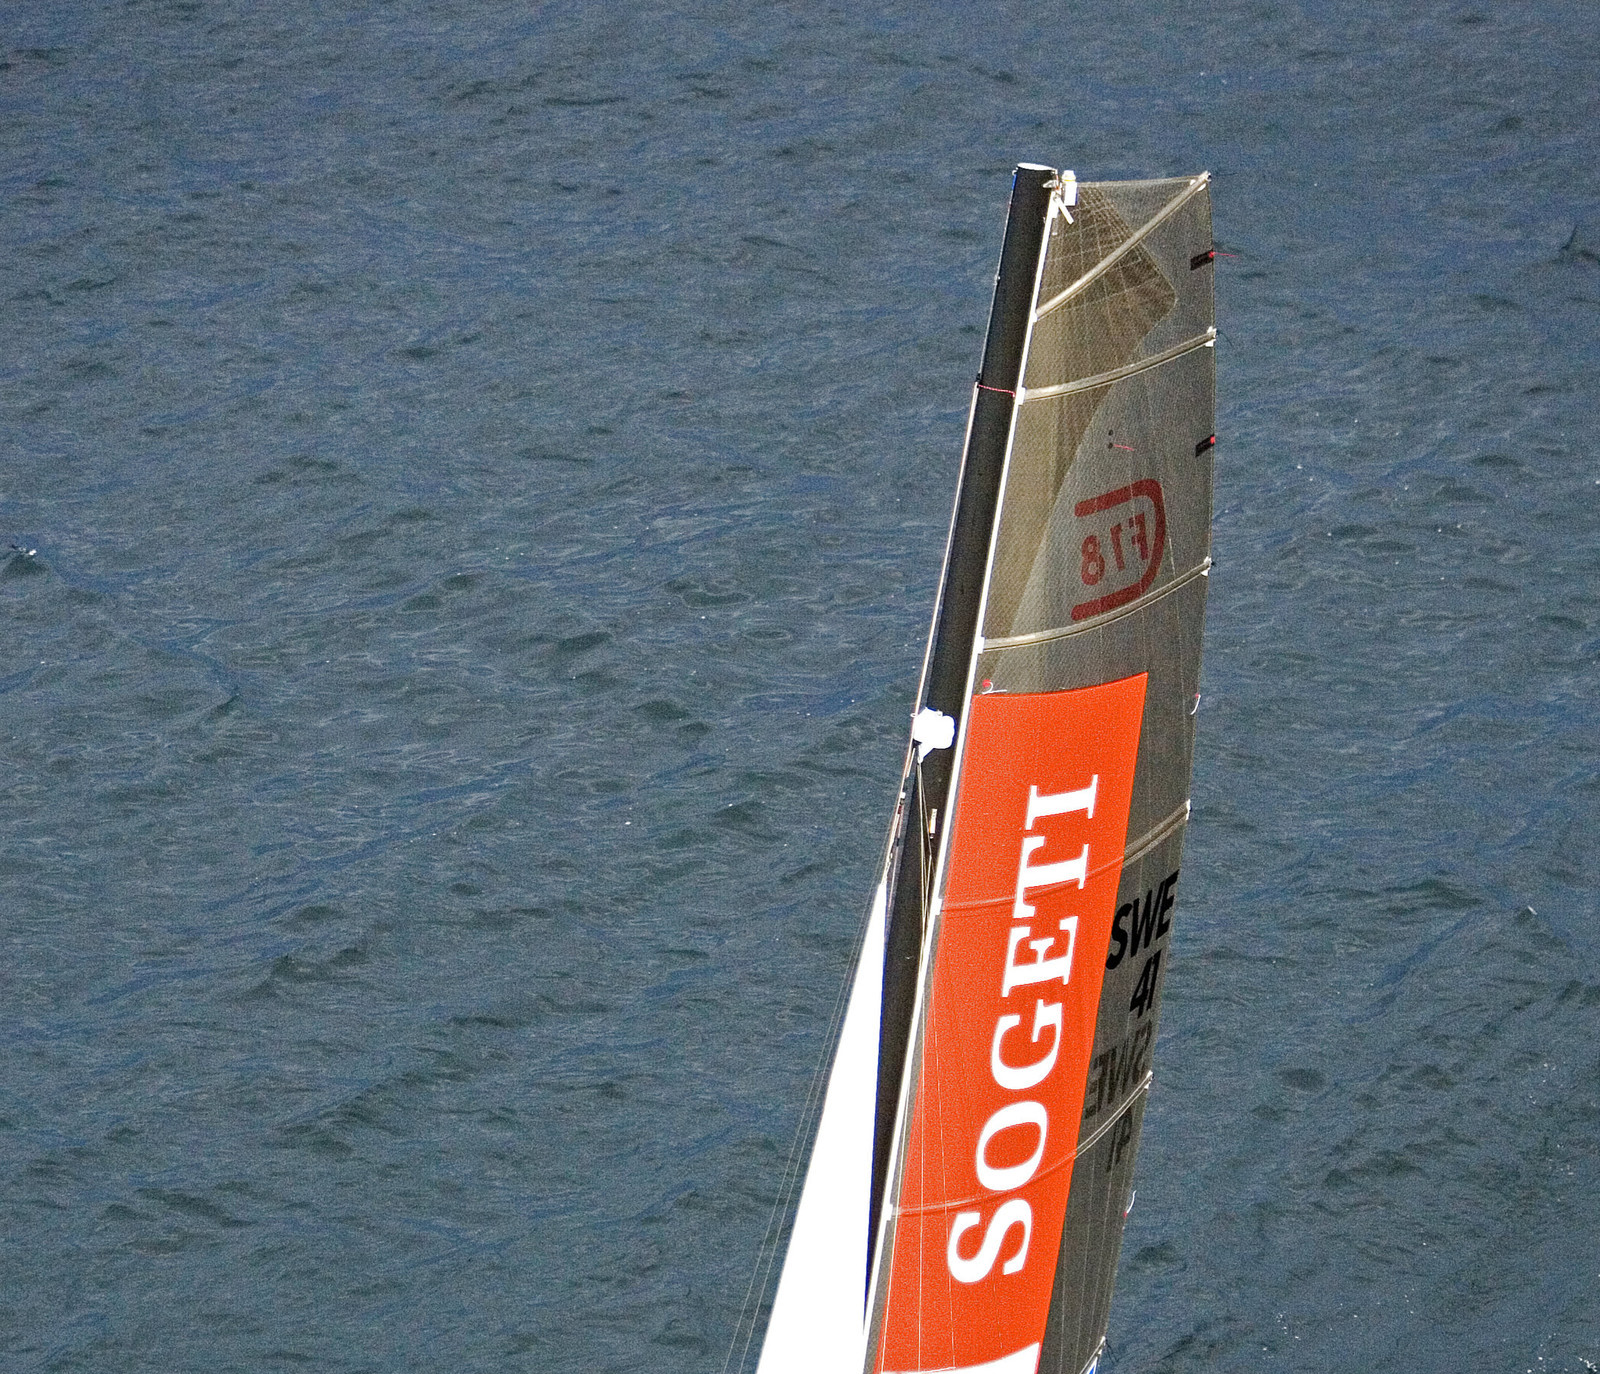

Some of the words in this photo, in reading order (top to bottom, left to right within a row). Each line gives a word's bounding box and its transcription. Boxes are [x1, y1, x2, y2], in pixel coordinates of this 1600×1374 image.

[1106, 869, 1181, 971] SWE
[946, 774, 1098, 1284] SOGETI
[1130, 949, 1162, 1019] 41
